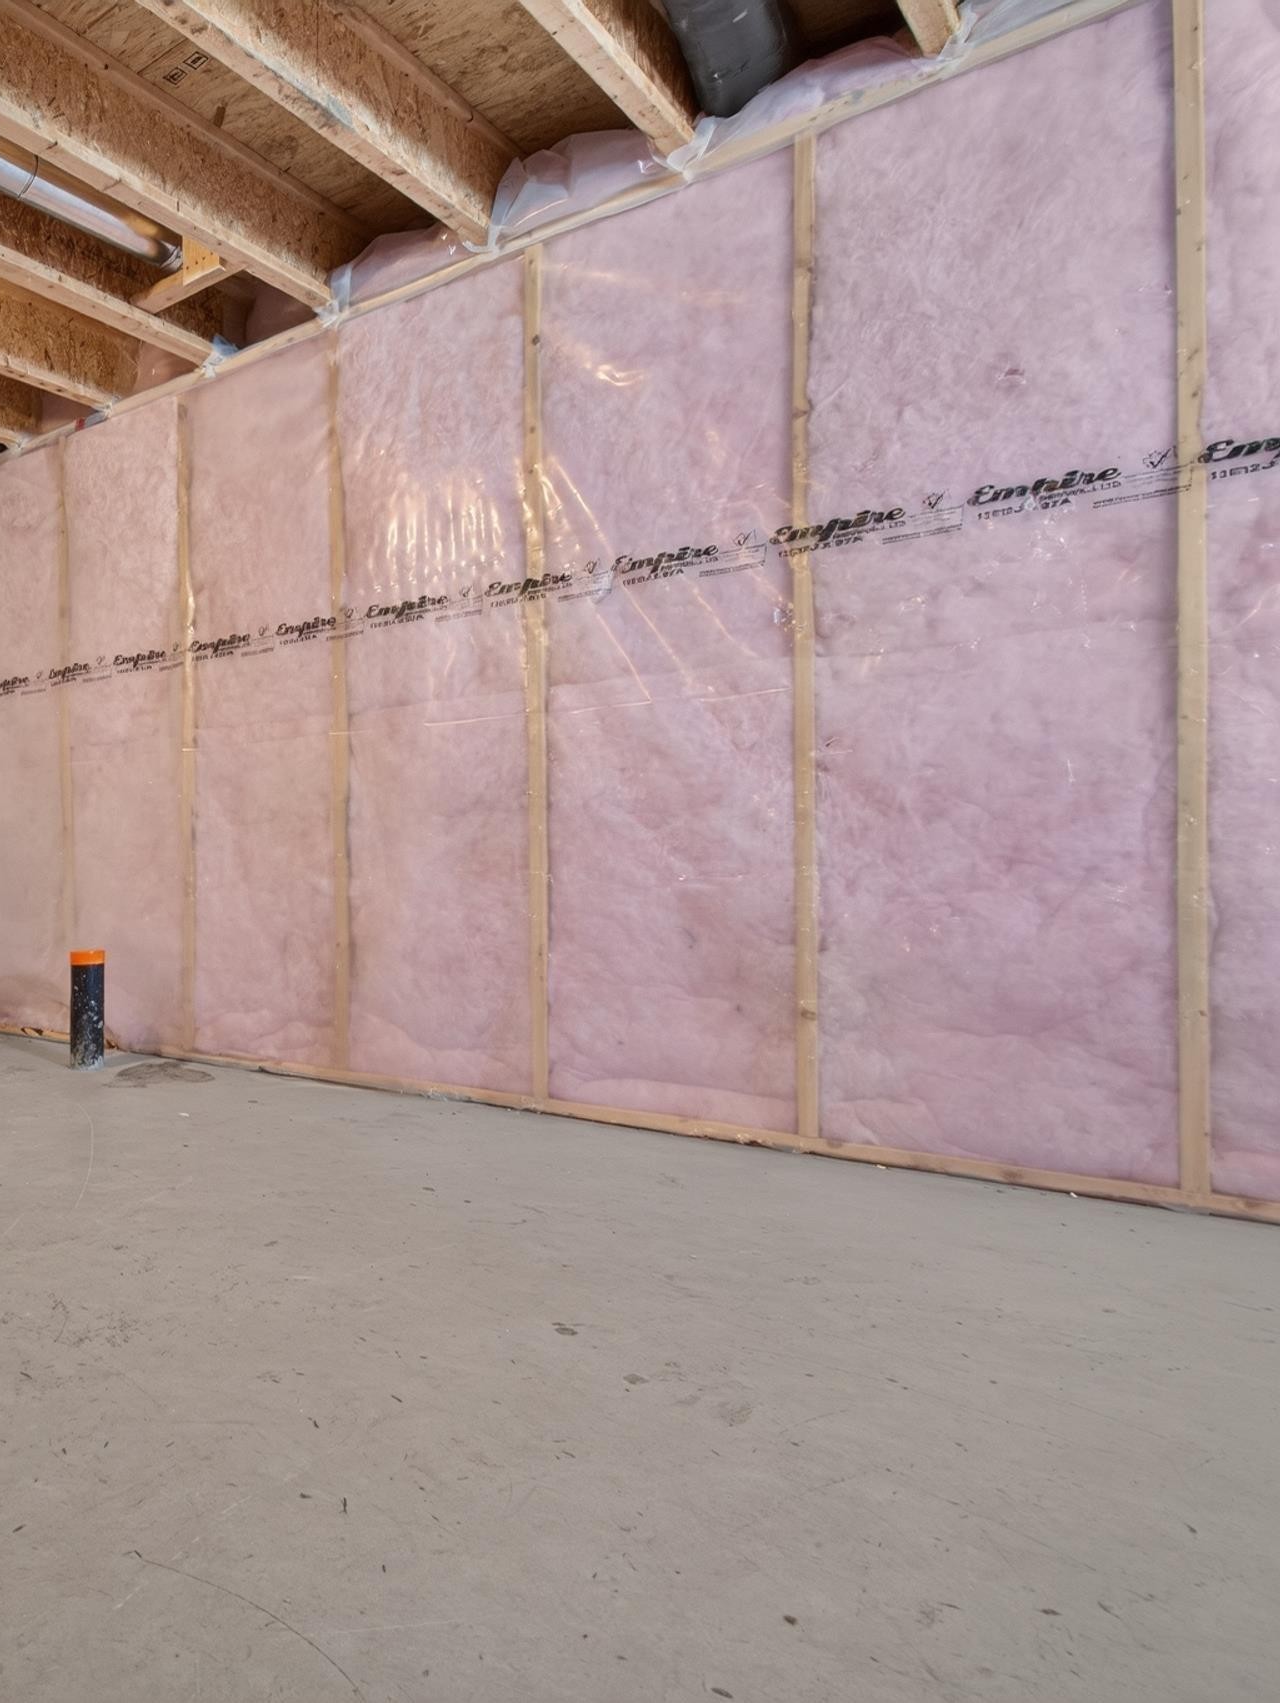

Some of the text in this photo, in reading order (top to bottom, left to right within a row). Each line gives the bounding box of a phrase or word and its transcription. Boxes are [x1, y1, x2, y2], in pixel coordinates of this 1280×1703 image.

[966, 467, 1122, 507] Empire
[769, 507, 907, 545] Empire
[610, 543, 719, 574] Empire
[483, 573, 573, 600] Empire
[365, 594, 449, 619] Empire
[275, 616, 337, 641] Empire
[191, 633, 251, 655] Empire
